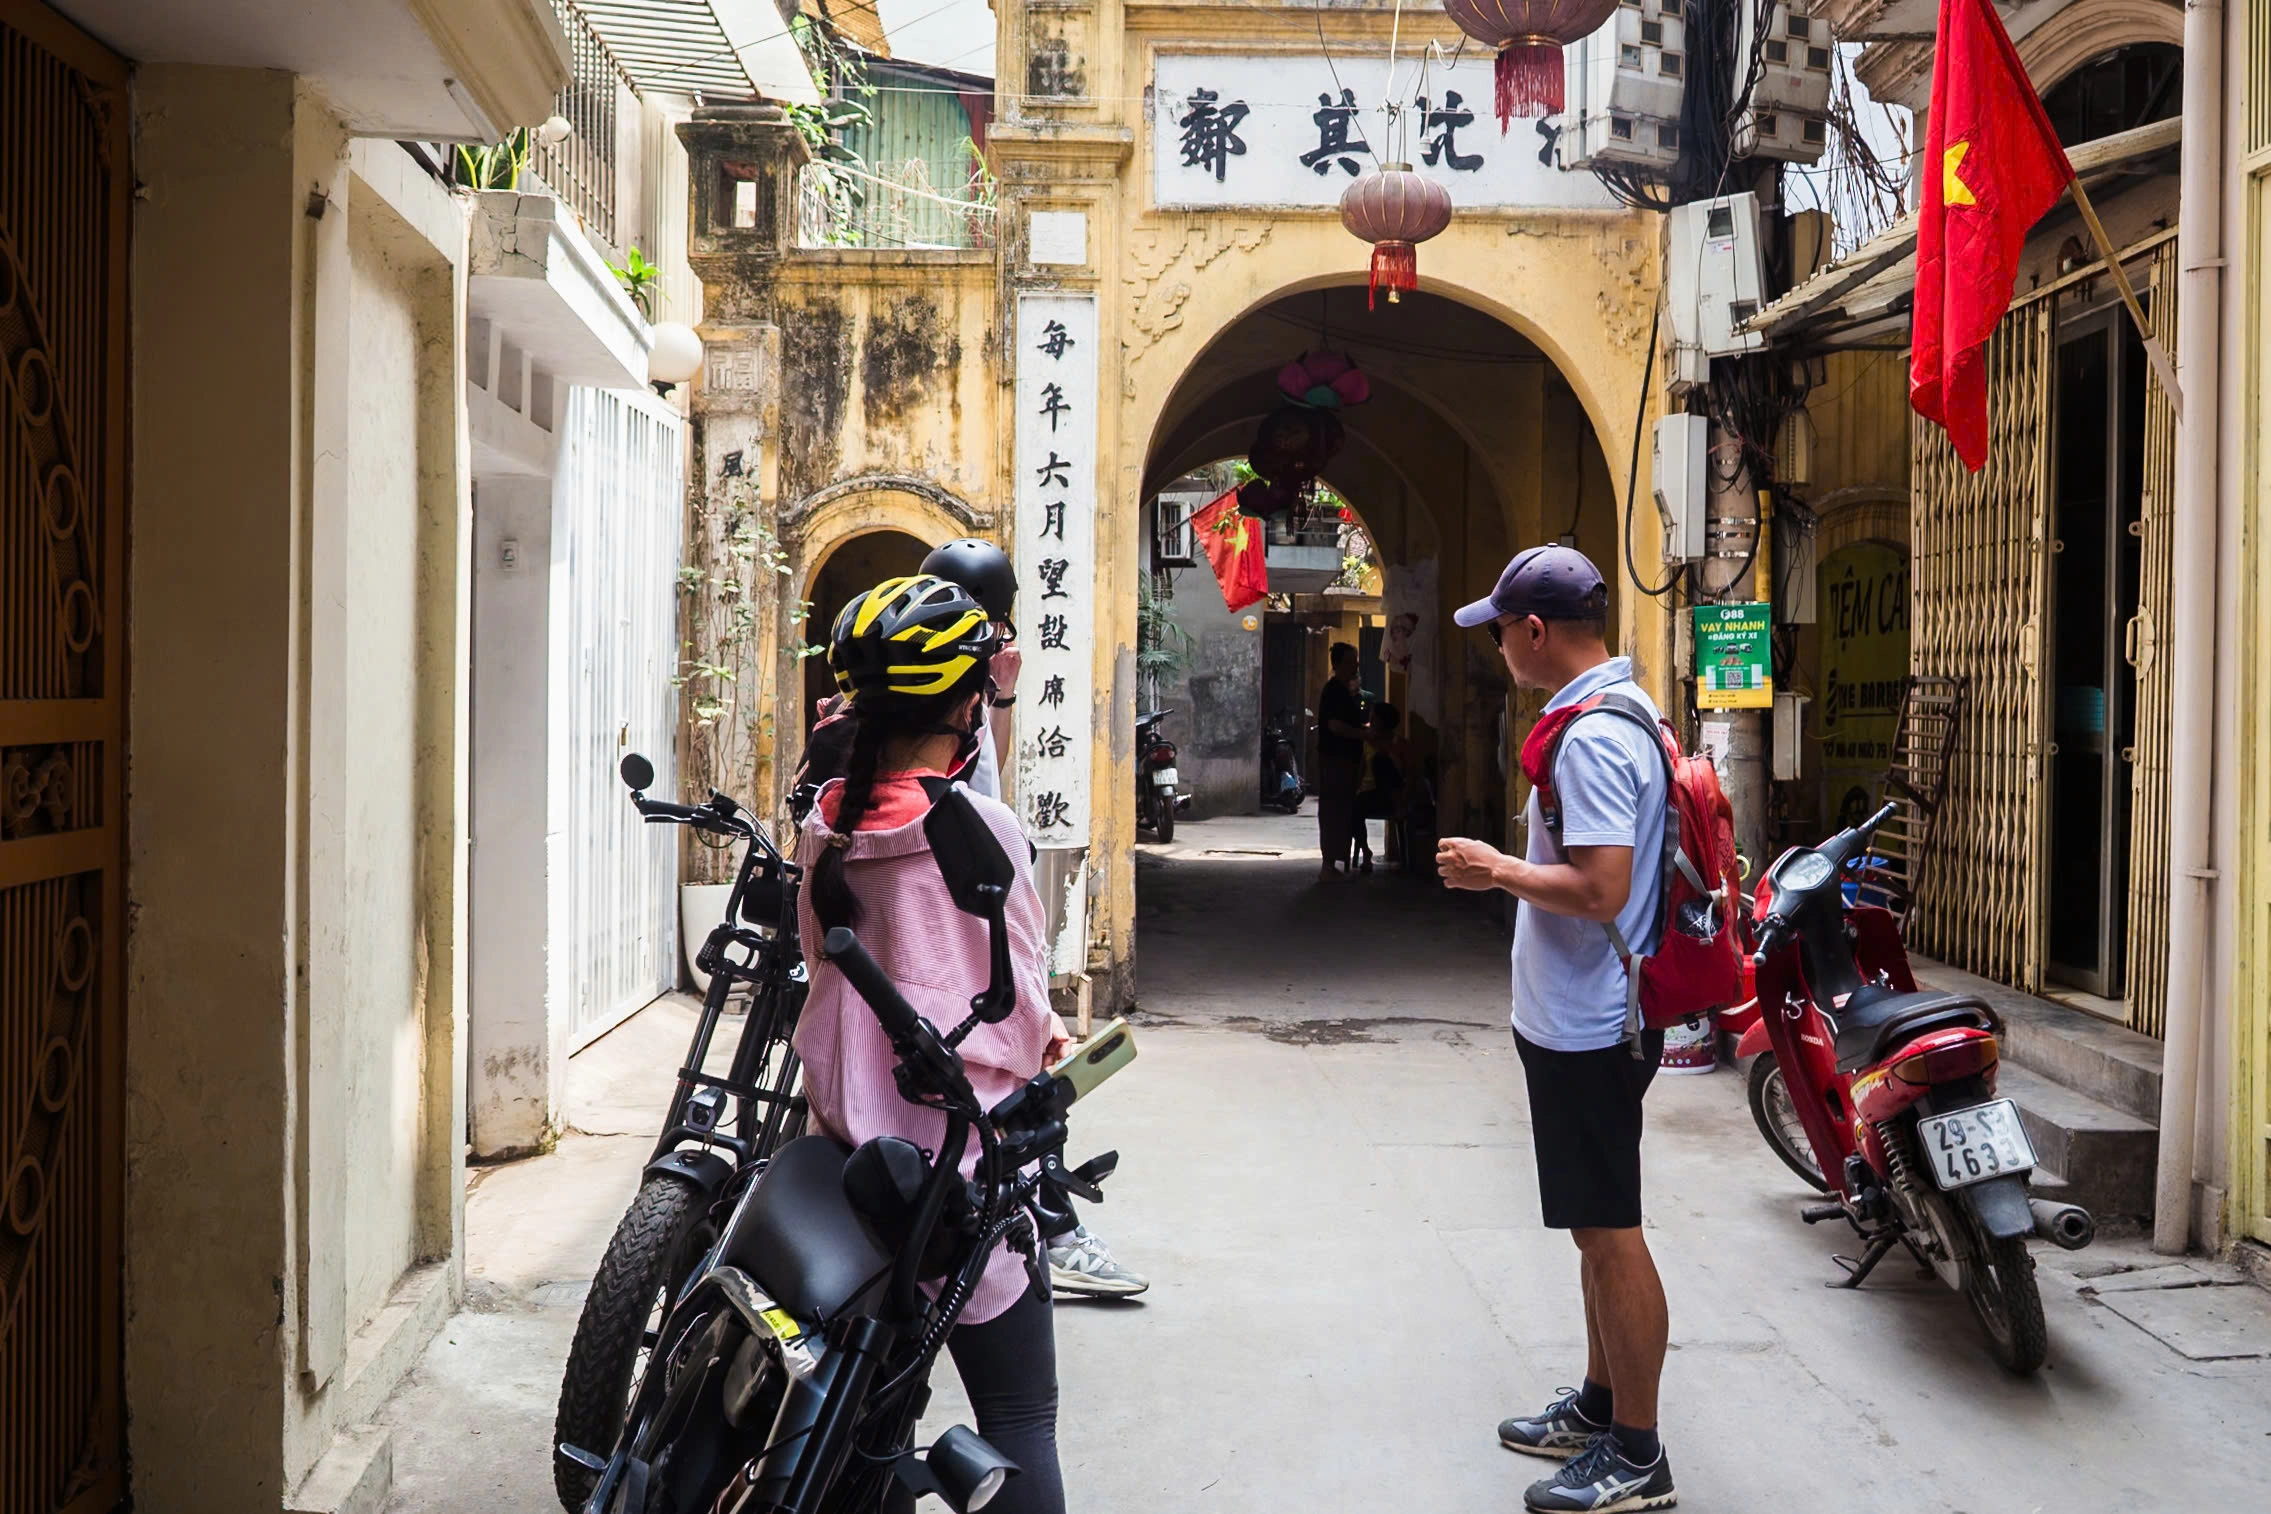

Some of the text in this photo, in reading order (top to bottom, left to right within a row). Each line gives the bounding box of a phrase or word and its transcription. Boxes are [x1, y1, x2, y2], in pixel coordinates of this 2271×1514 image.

[1701, 620, 1765, 632] VAY NHANH
[1801, 1033, 1824, 1047] HONDA
